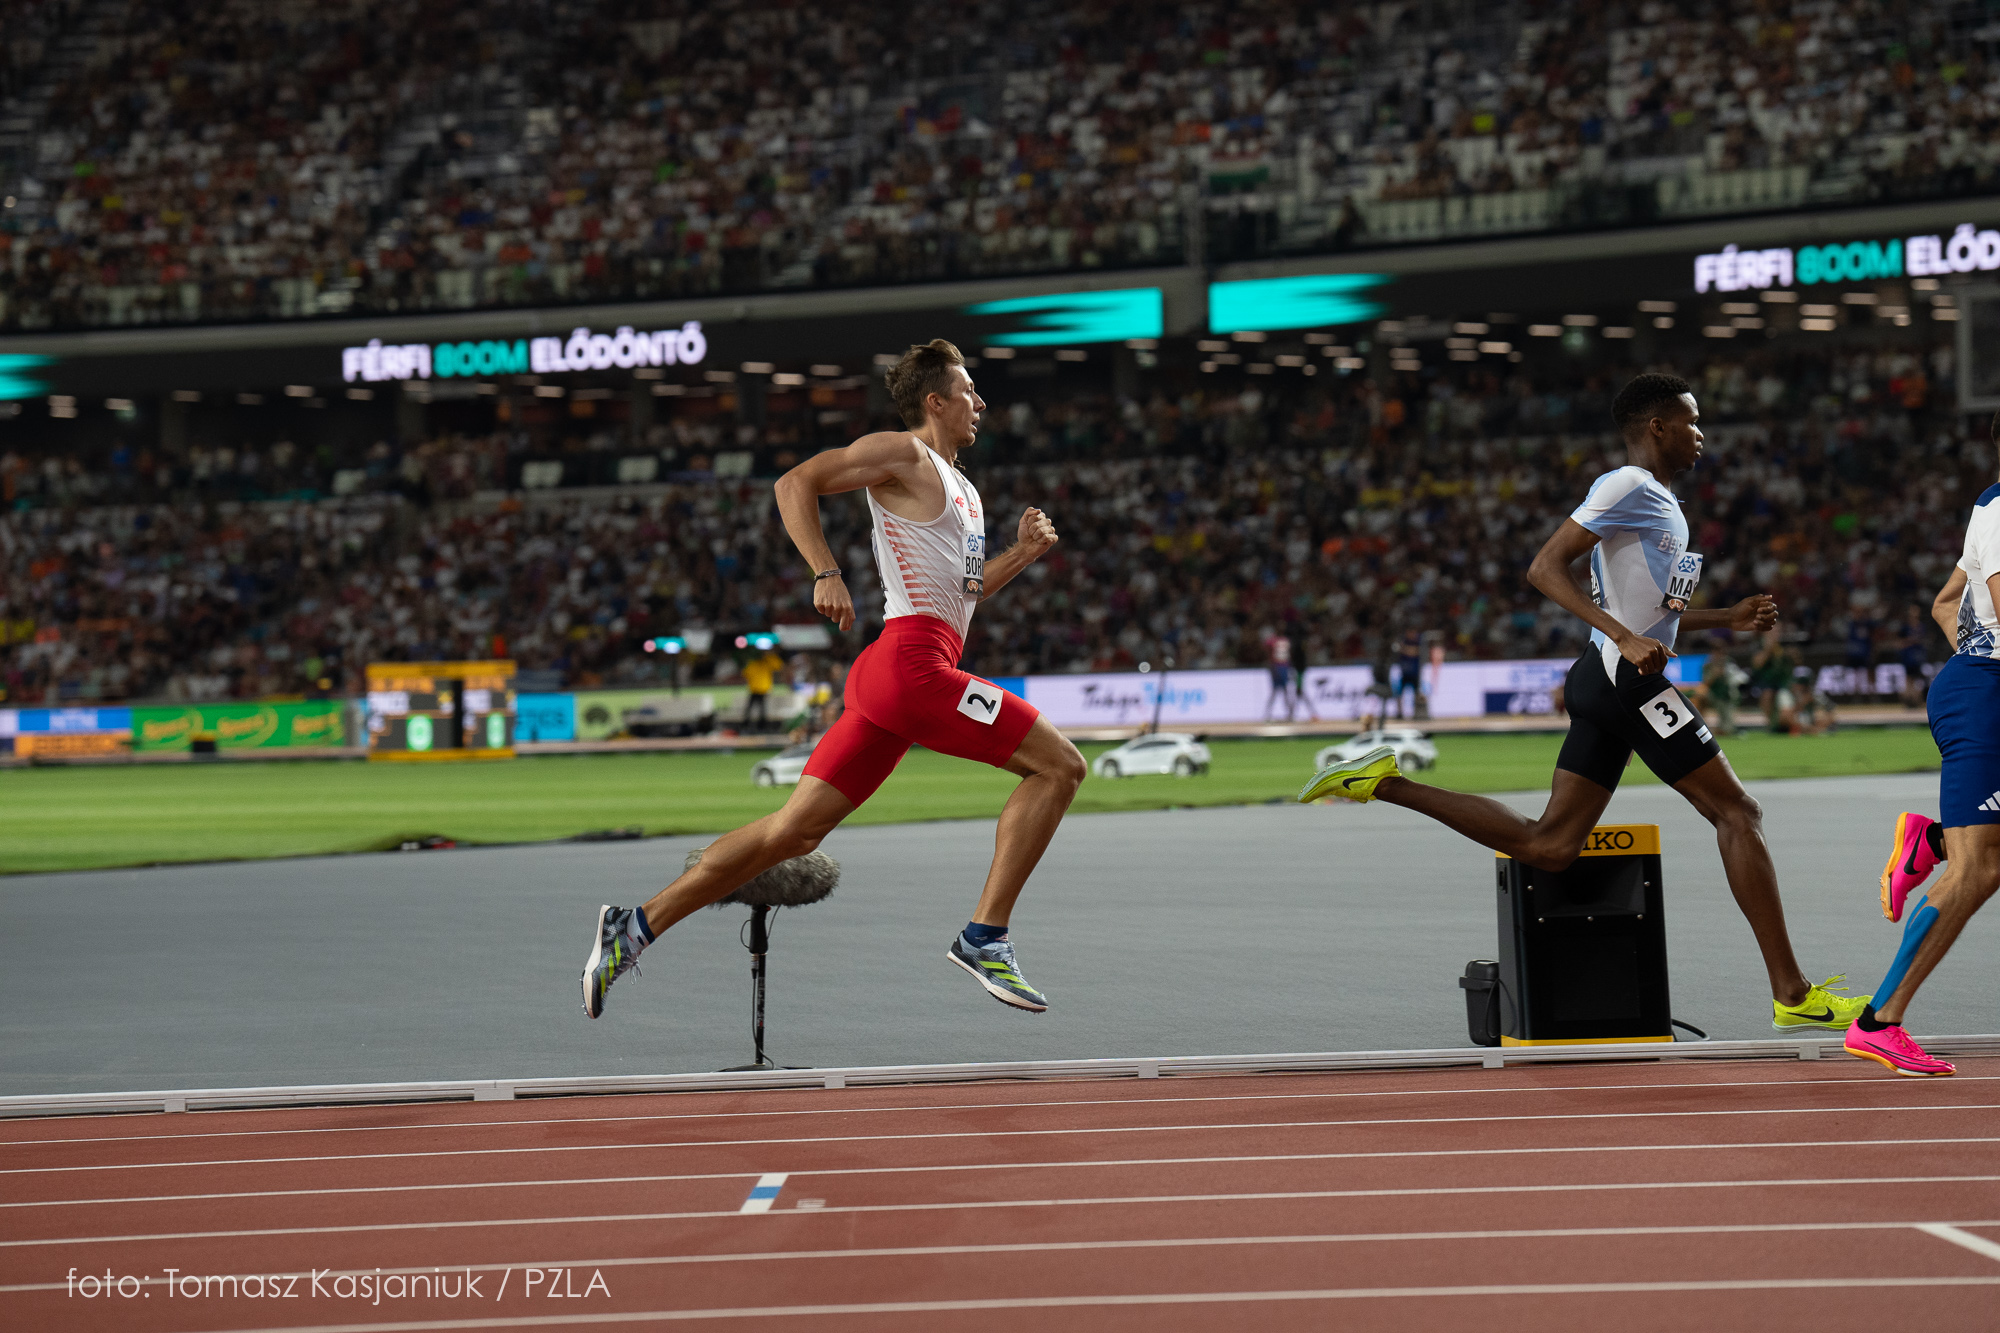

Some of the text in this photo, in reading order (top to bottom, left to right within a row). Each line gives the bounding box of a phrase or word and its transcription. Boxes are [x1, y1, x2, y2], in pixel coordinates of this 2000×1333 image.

[1694, 243, 1793, 293] FÉRFI
[342, 338, 432, 382] FÉRFI
[966, 556, 984, 576] BOR
[1669, 576, 1695, 598] MA
[967, 693, 997, 714] 2
[1654, 701, 1679, 728] 3
